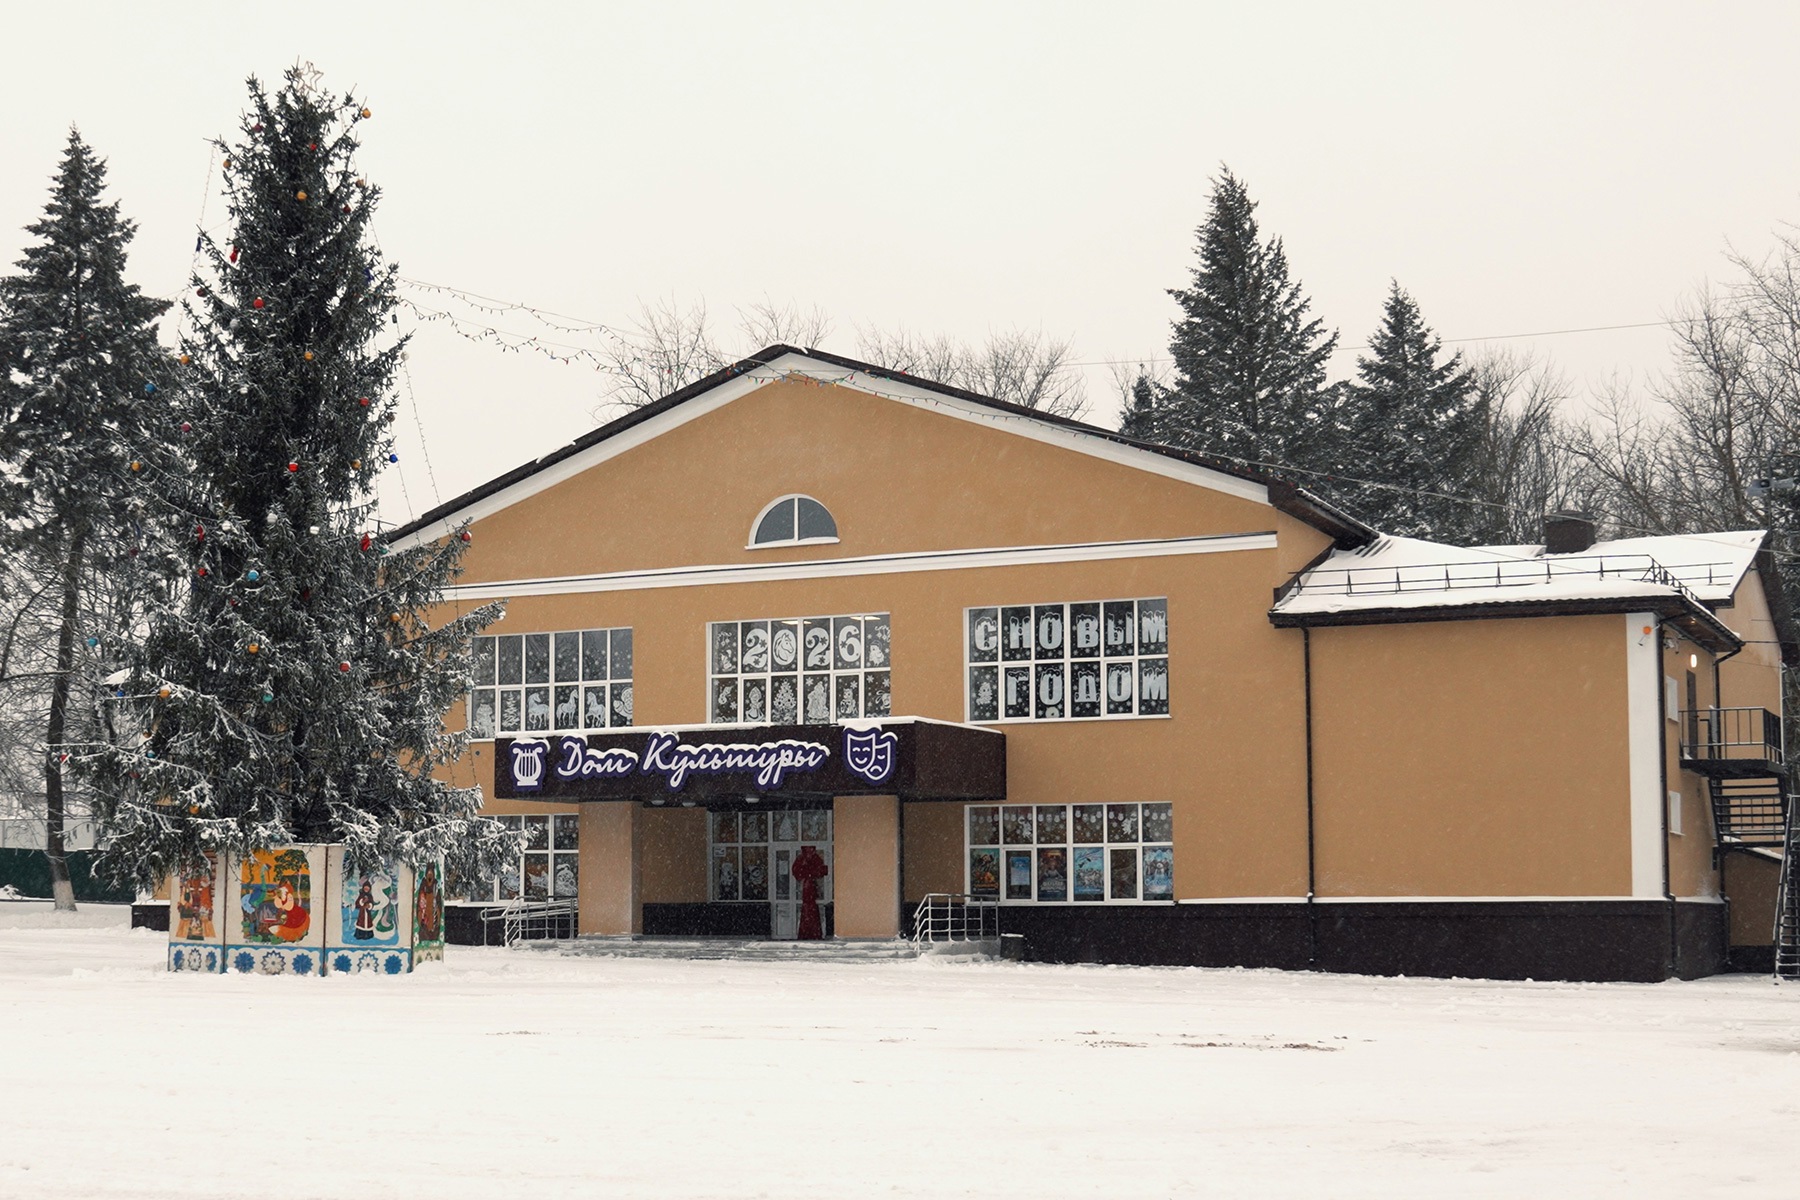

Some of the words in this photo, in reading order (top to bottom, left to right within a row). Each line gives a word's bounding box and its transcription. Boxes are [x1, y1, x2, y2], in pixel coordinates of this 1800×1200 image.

[742, 625, 862, 669] 2026
[1006, 664, 1168, 706] ГОДОМ
[557, 740, 632, 777] Дом
[642, 738, 823, 788] Культуры
